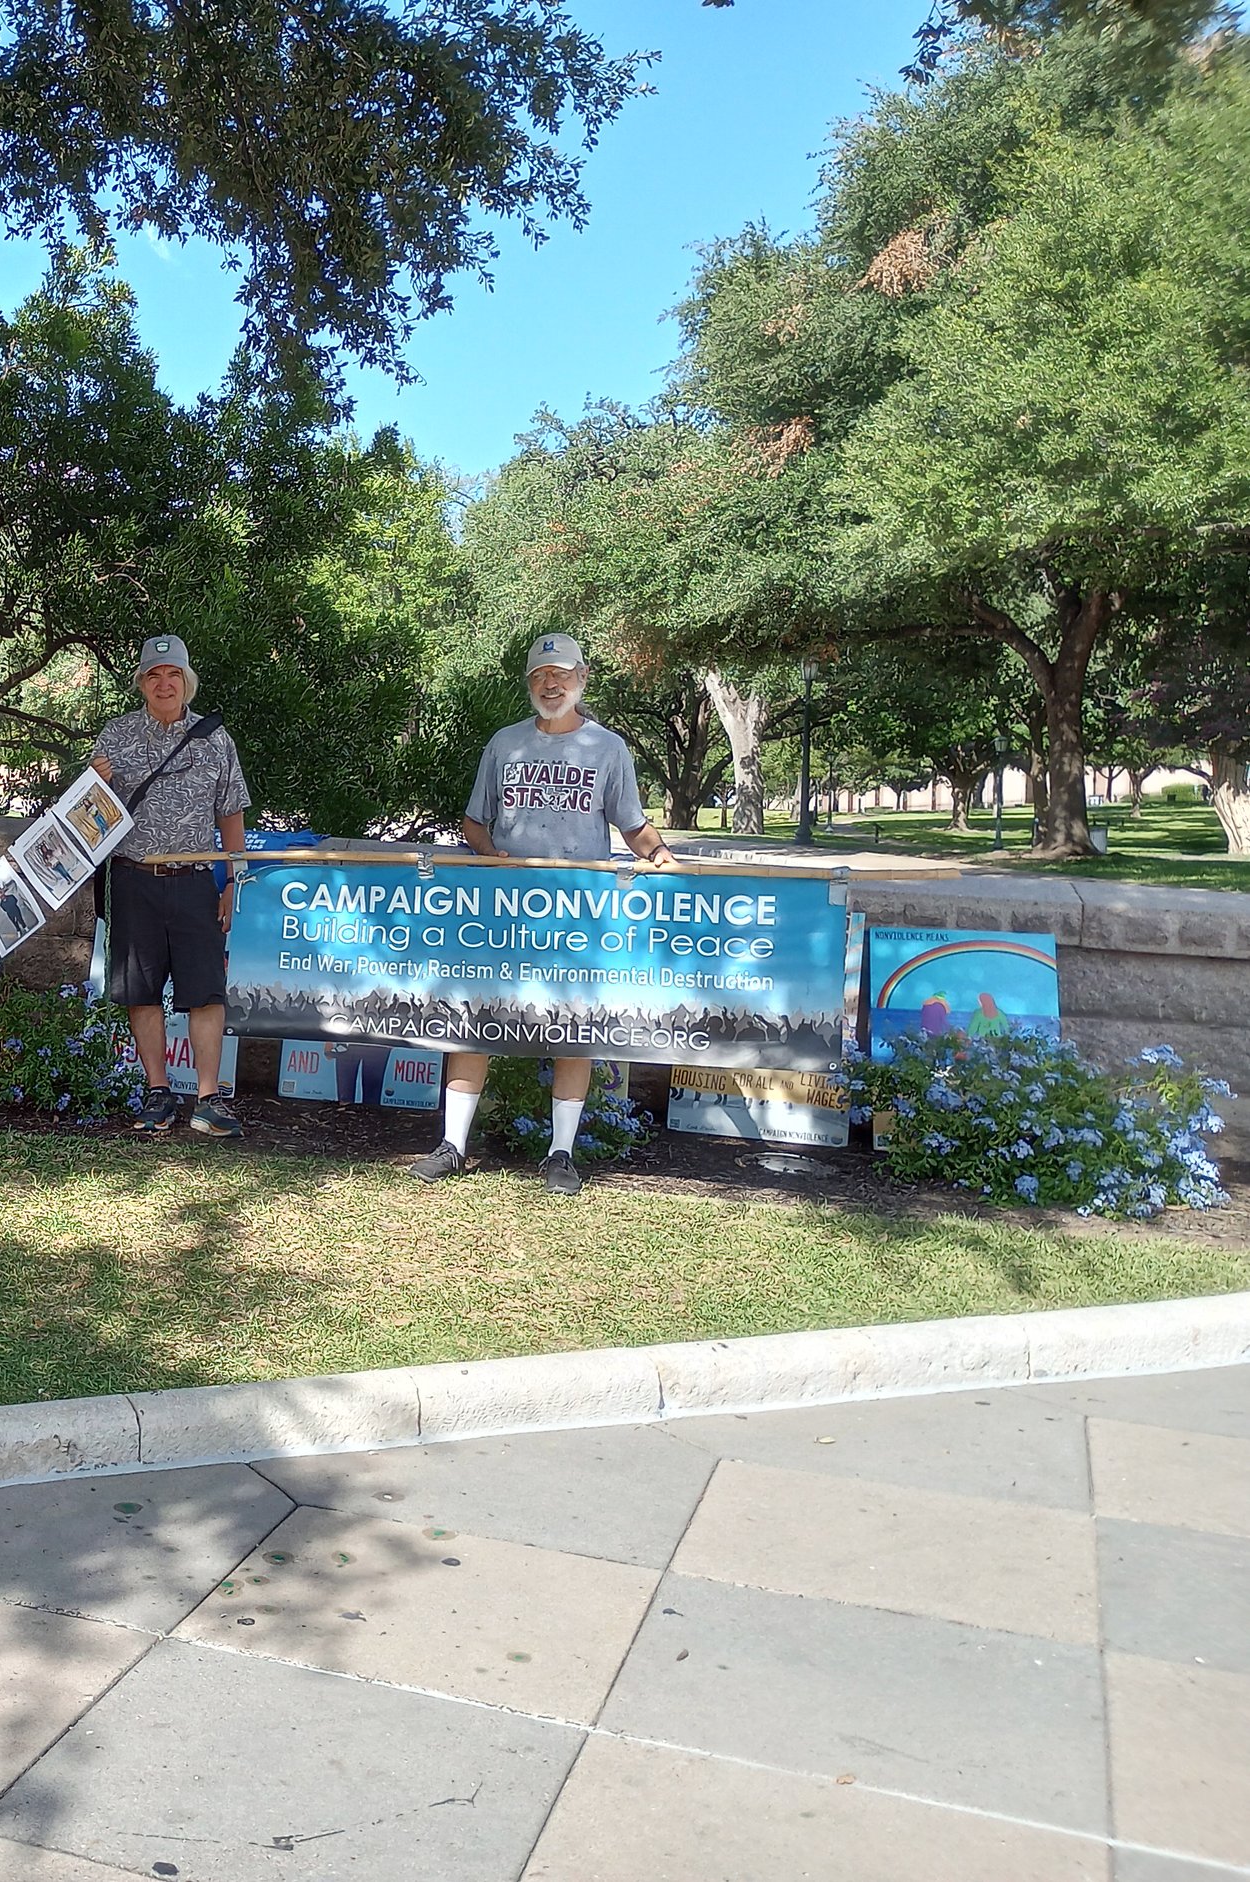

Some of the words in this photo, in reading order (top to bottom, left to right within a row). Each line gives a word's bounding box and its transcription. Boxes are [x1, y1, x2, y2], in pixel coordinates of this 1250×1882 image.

[502, 762, 597, 789] UVALDE
[281, 881, 480, 917] CAMPAIGN
[494, 887, 777, 926] NONVIOLENCE
[282, 915, 411, 951] Building
[422, 926, 445, 947] a
[458, 922, 589, 951] Culture
[601, 925, 638, 952] of
[649, 928, 774, 959] Peace
[875, 931, 923, 941] NONVIOLENCE
[279, 952, 312, 971] End
[500, 963, 513, 980] &
[519, 962, 655, 986] Environmental
[660, 968, 774, 992] Destruction
[329, 1014, 711, 1051] CAMPAIGNNONVIOLENCE.ORG
[166, 1037, 196, 1069] WA
[286, 1050, 320, 1074] AND
[393, 1059, 438, 1085] MORE
[672, 1069, 727, 1091] HOUSING
[733, 1072, 755, 1087] FOR
[755, 1074, 774, 1091] ALL
[781, 1080, 794, 1091] AND
[759, 1128, 787, 1139] CAMPAIGN
